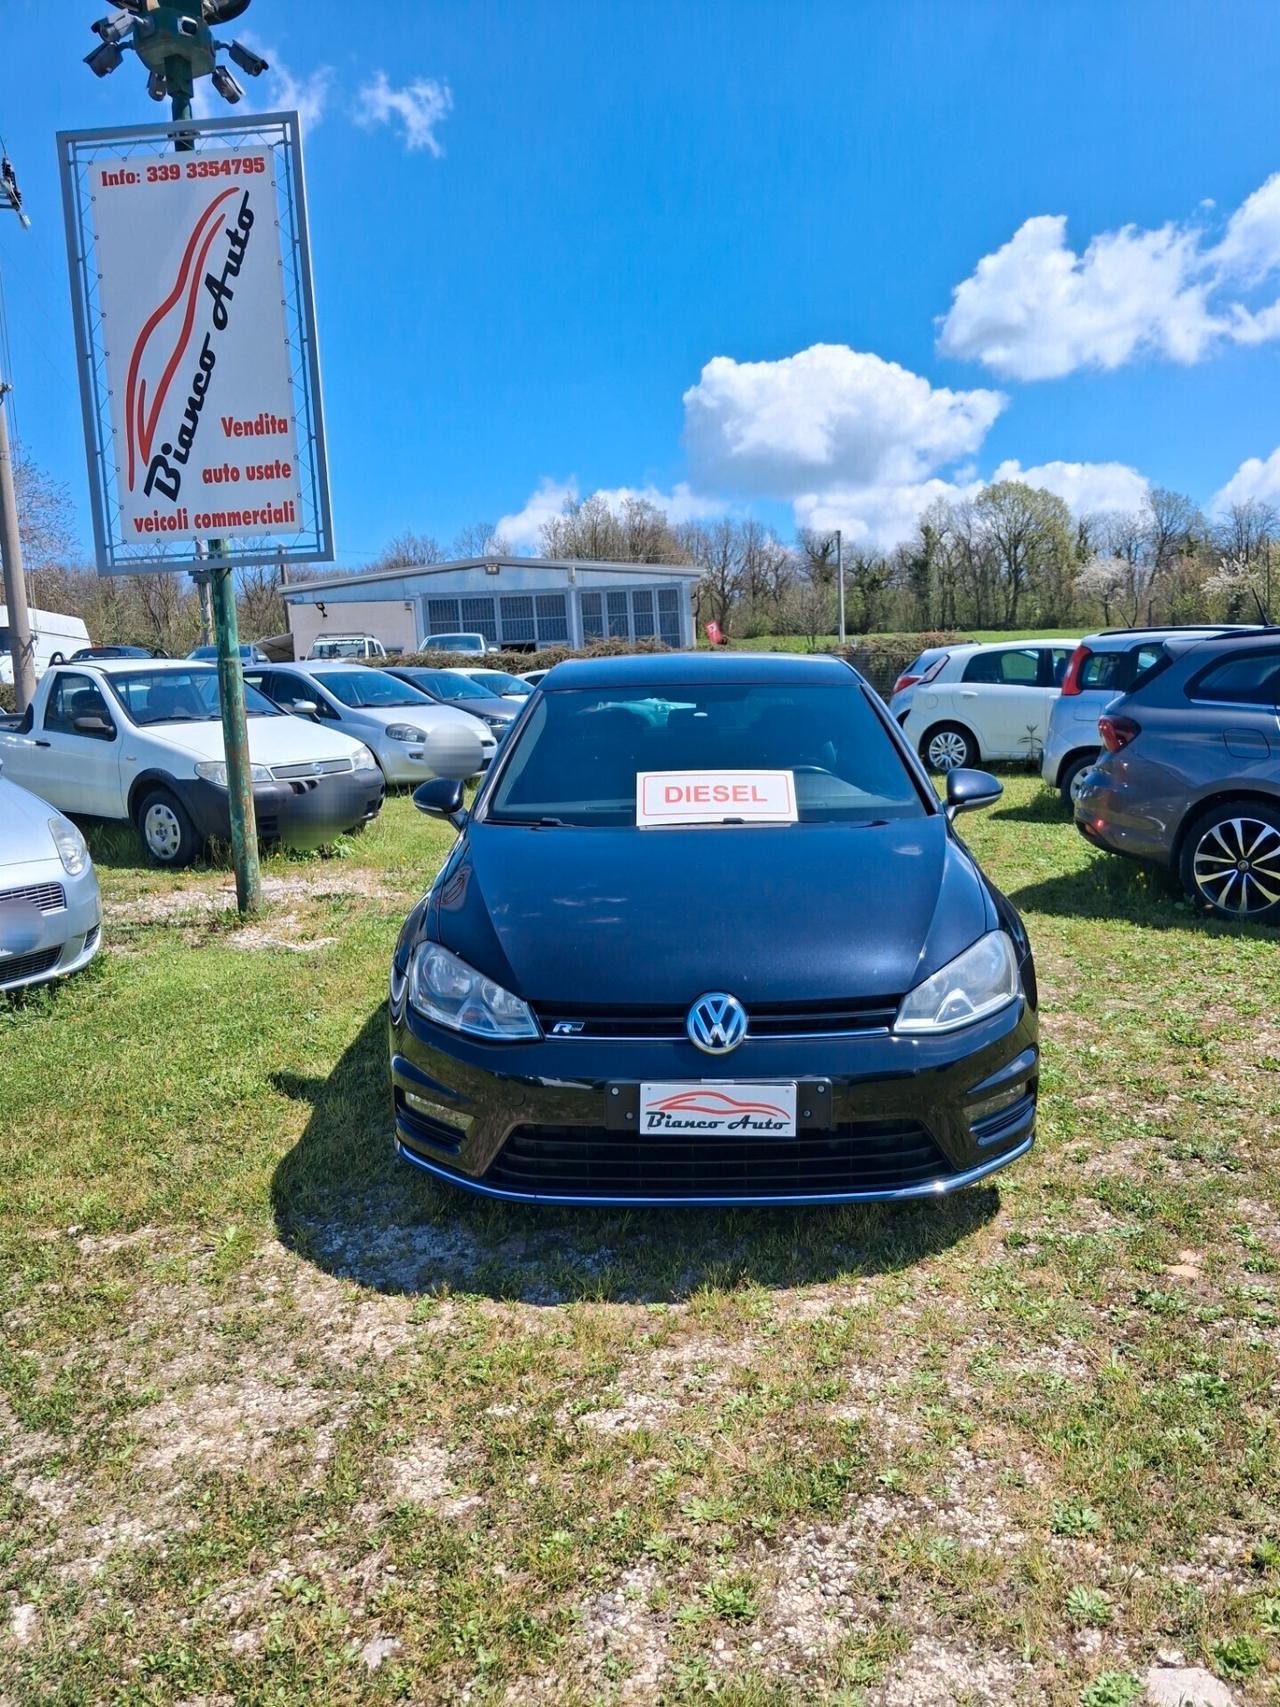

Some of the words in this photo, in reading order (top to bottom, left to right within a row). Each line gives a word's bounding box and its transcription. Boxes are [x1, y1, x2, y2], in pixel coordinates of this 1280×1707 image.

[101, 168, 141, 187] Info:
[146, 164, 181, 182] 339
[186, 157, 265, 179] 3354795
[143, 332, 216, 503] Bianco
[205, 190, 255, 331] Auto
[221, 413, 288, 437] Vendita
[202, 463, 240, 484] auto
[246, 460, 292, 481] usate
[133, 508, 189, 532] veicoli
[194, 501, 295, 529] commerciali
[664, 785, 768, 804] DIESEL
[646, 1111, 725, 1129] Bianco
[727, 1114, 791, 1130] Auto
